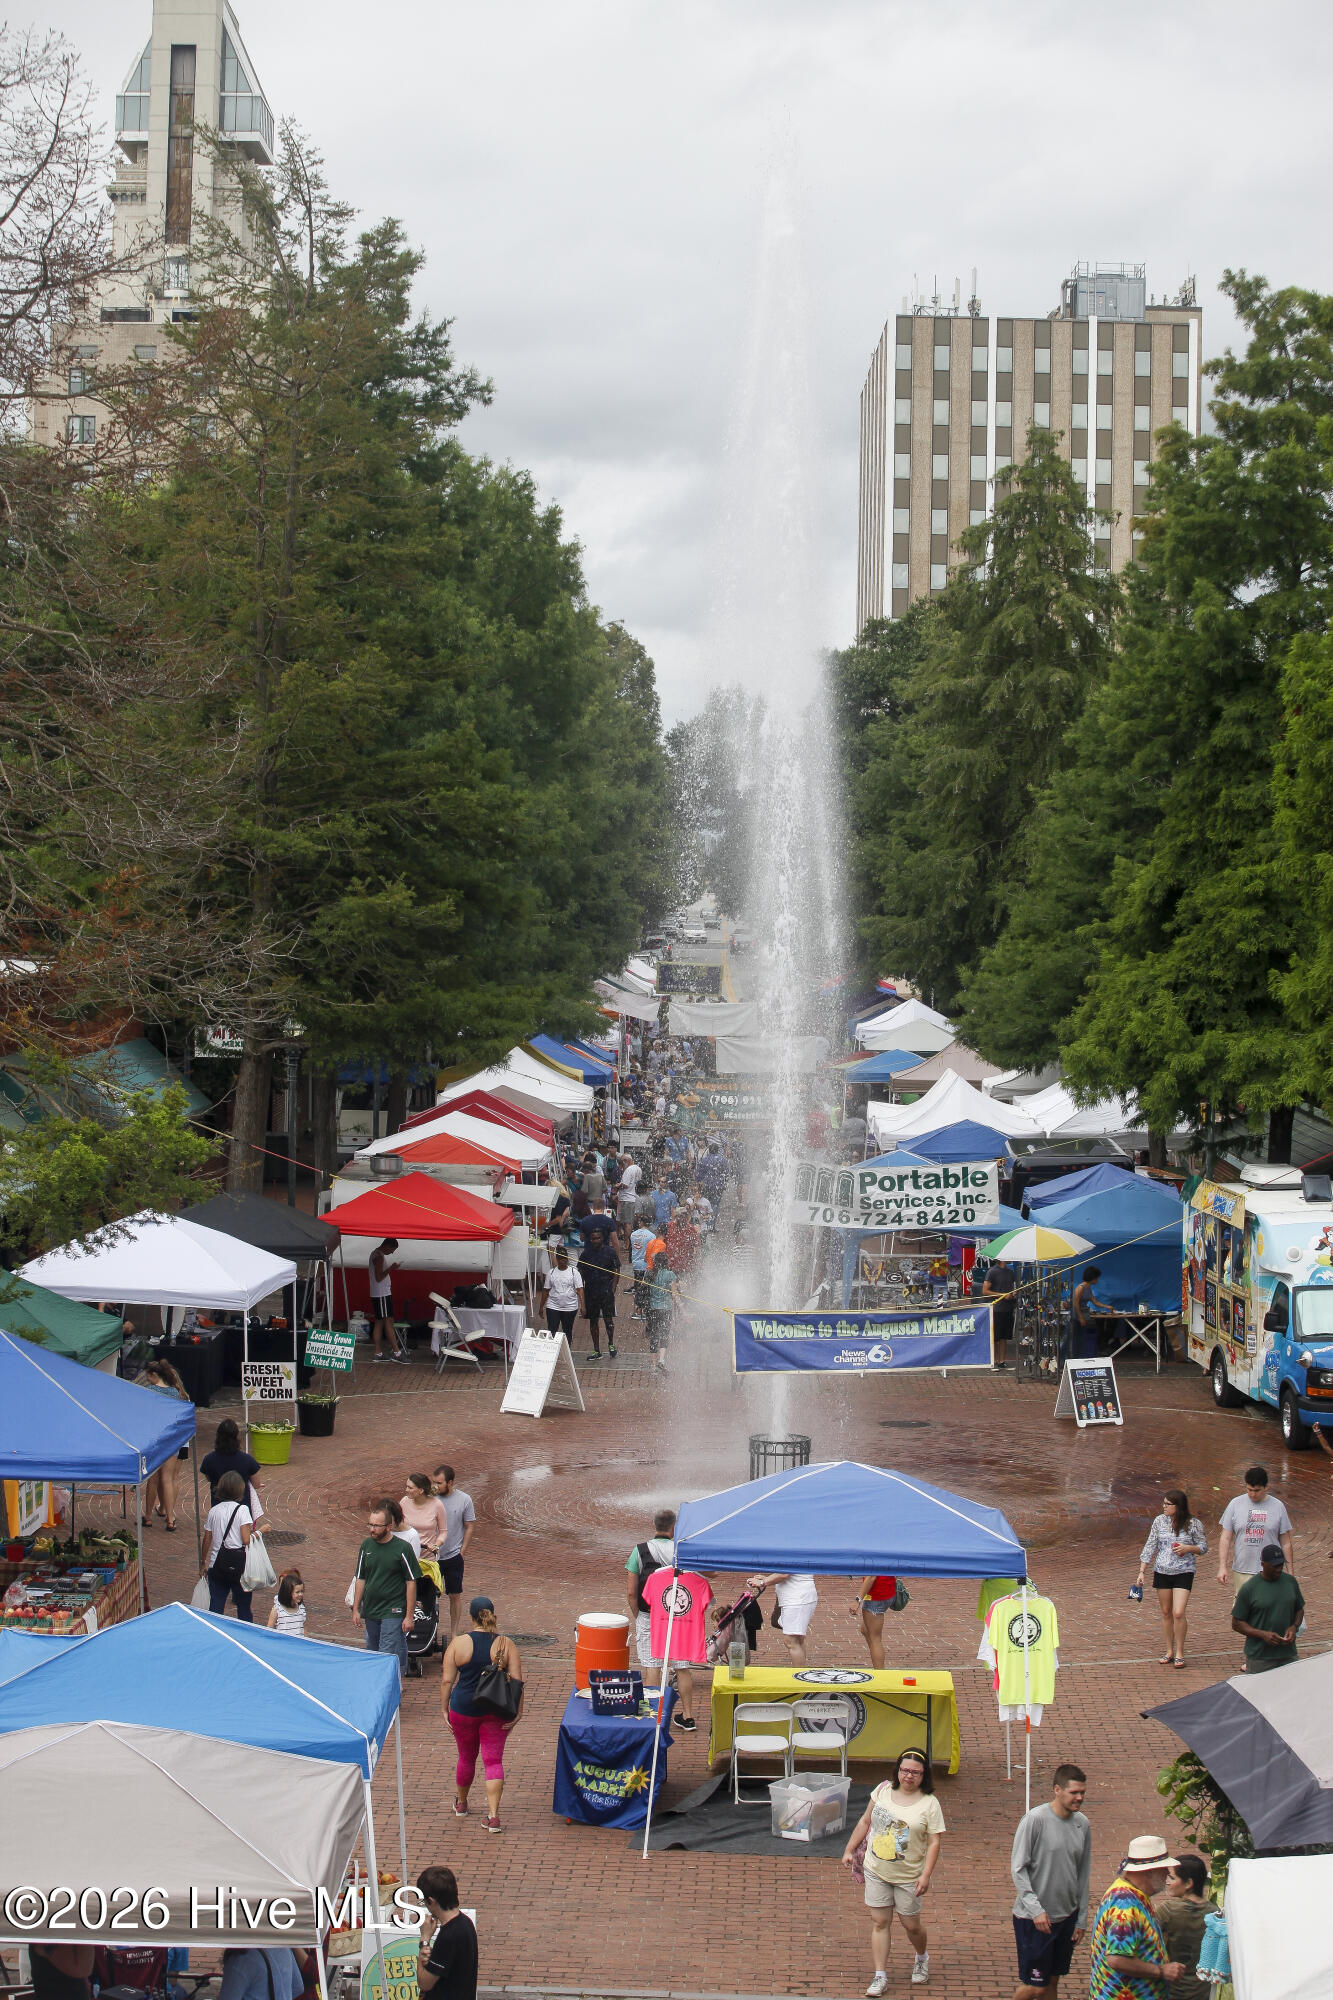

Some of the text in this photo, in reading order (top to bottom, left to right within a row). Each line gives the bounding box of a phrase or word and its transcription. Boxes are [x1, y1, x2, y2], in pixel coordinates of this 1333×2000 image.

[221, 1040, 244, 1048] MEXI
[709, 1095, 739, 1107] (706)
[859, 1167, 989, 1194] Portable
[859, 1192, 992, 1210] Services, Inc.
[808, 1207, 976, 1227] 706-724-8420
[750, 1314, 976, 1341] Welcome to the Augusta Market
[310, 1330, 352, 1345] Locally Grown
[307, 1342, 353, 1358] Insecticide Free
[841, 1343, 887, 1364] News 6
[310, 1355, 347, 1369] Picked Fresh
[833, 1355, 868, 1363] Channel
[243, 1364, 280, 1375] FRESH
[243, 1376, 285, 1387] SWEET
[260, 1388, 293, 1399] CORN
[574, 1777, 634, 1798] MARKET
